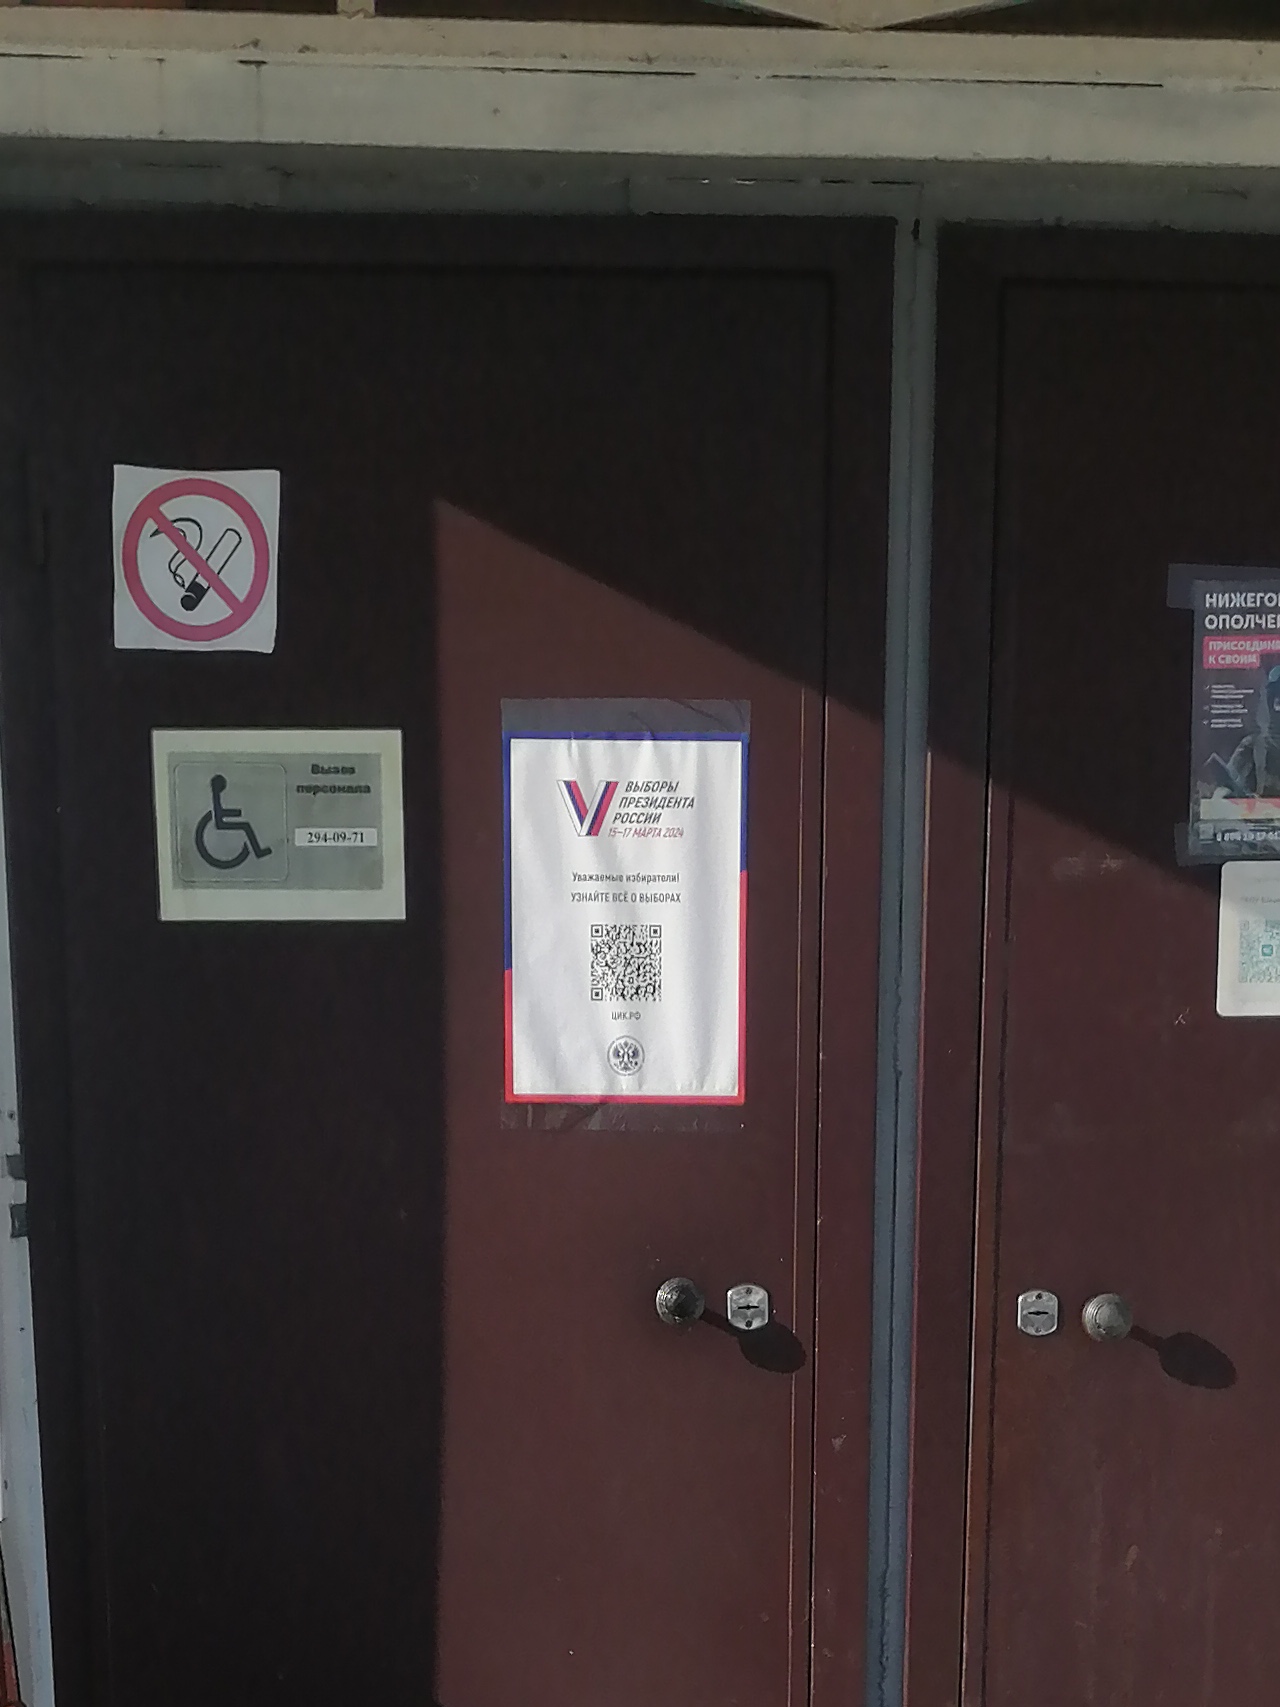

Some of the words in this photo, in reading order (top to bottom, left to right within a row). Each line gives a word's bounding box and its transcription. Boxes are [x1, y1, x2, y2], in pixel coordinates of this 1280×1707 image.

[1208, 655, 1216, 664] К
[1218, 654, 1257, 664] СВОИМ
[296, 784, 371, 797] персонала
[624, 780, 680, 794] ВЫБОРЫ
[618, 796, 696, 810] ПРЕЗИДЕНТА
[612, 812, 662, 825] РОССИИ
[307, 831, 365, 844] 294-09-71
[632, 827, 662, 838] МАРТА
[663, 827, 685, 838] 2024
[572, 871, 624, 883] Уважаемые
[625, 872, 680, 885] избиратели!
[571, 889, 610, 903] УЗНАЙТЕ
[612, 890, 629, 903] ВСЁ
[630, 892, 637, 903] О
[639, 892, 681, 904] ВЫБОРАХ
[611, 1011, 641, 1021] ЦИК.РФ
